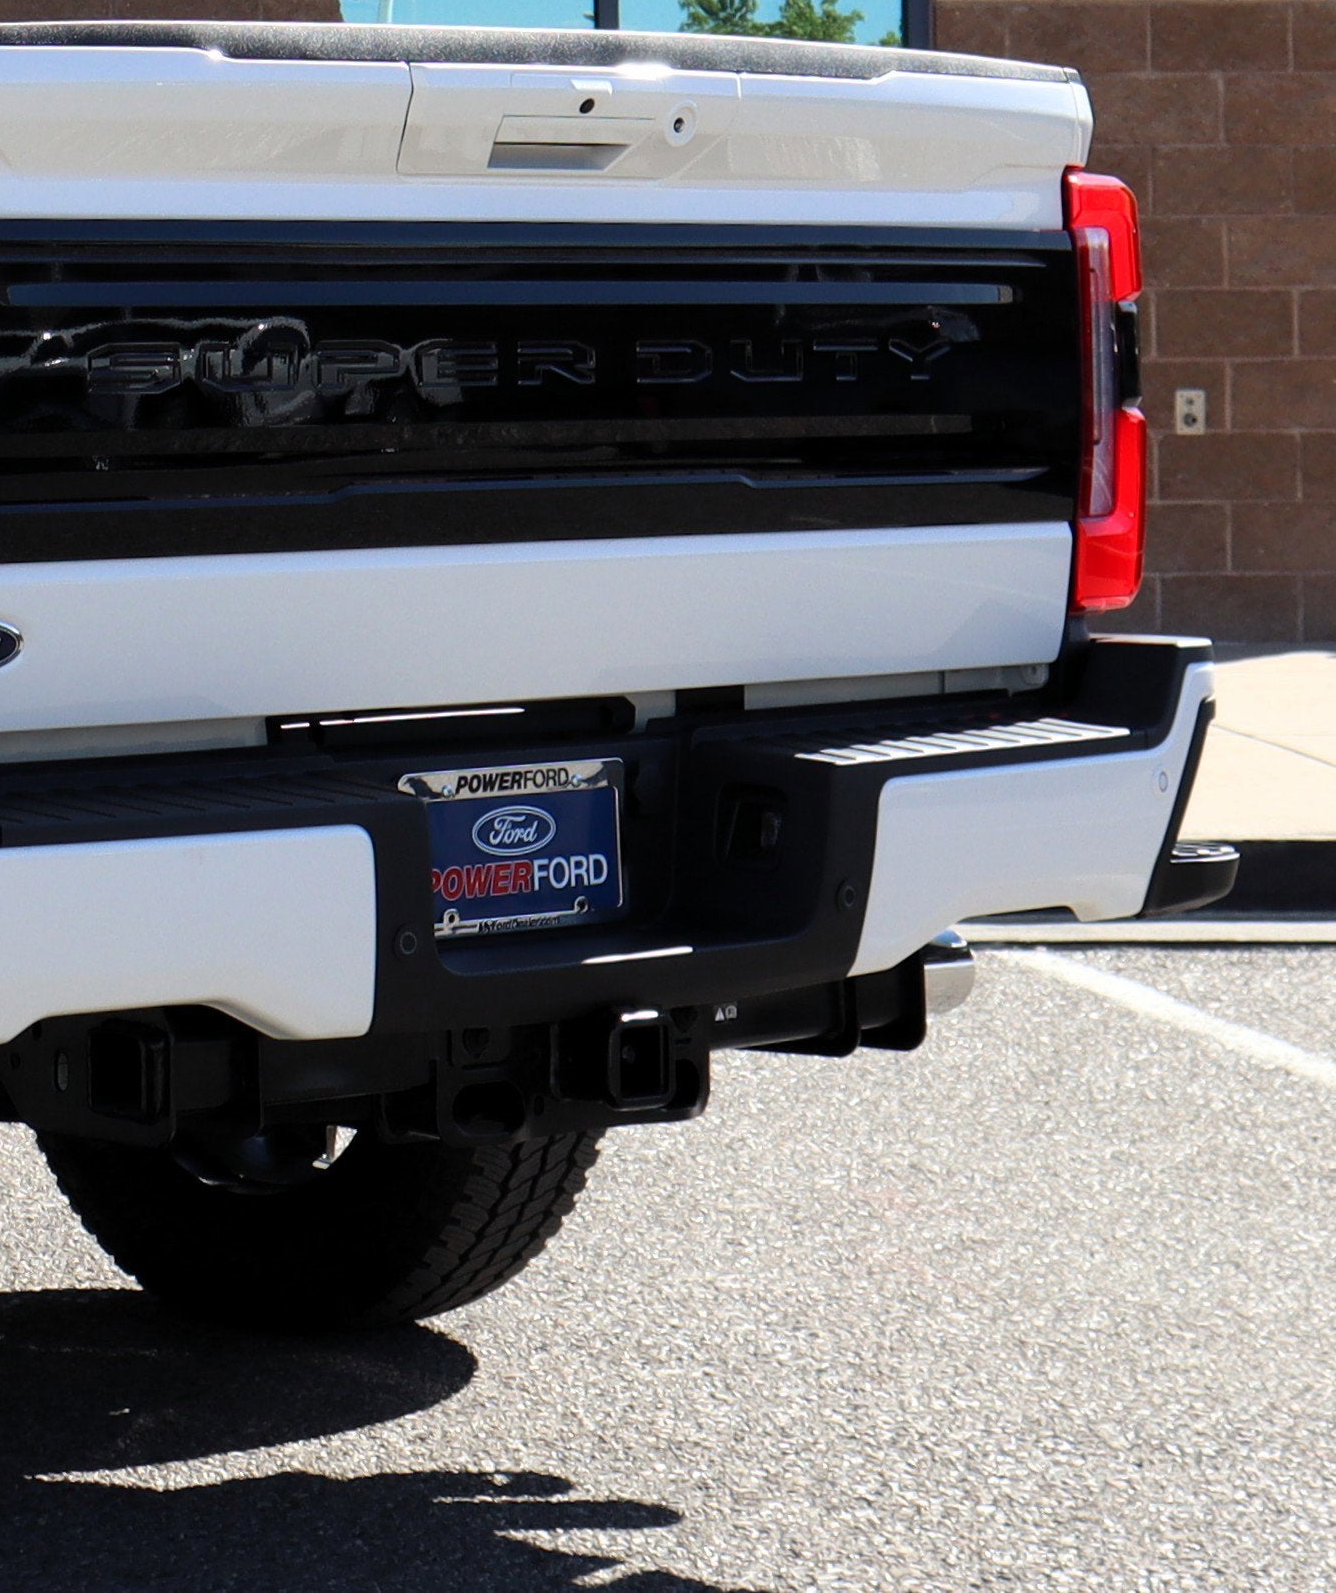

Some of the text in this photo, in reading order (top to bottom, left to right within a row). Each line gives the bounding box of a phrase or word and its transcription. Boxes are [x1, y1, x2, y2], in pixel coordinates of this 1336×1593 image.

[86, 338, 952, 395] SUPER DUTY
[455, 768, 570, 794] POWERFORD
[489, 815, 539, 845] Ford
